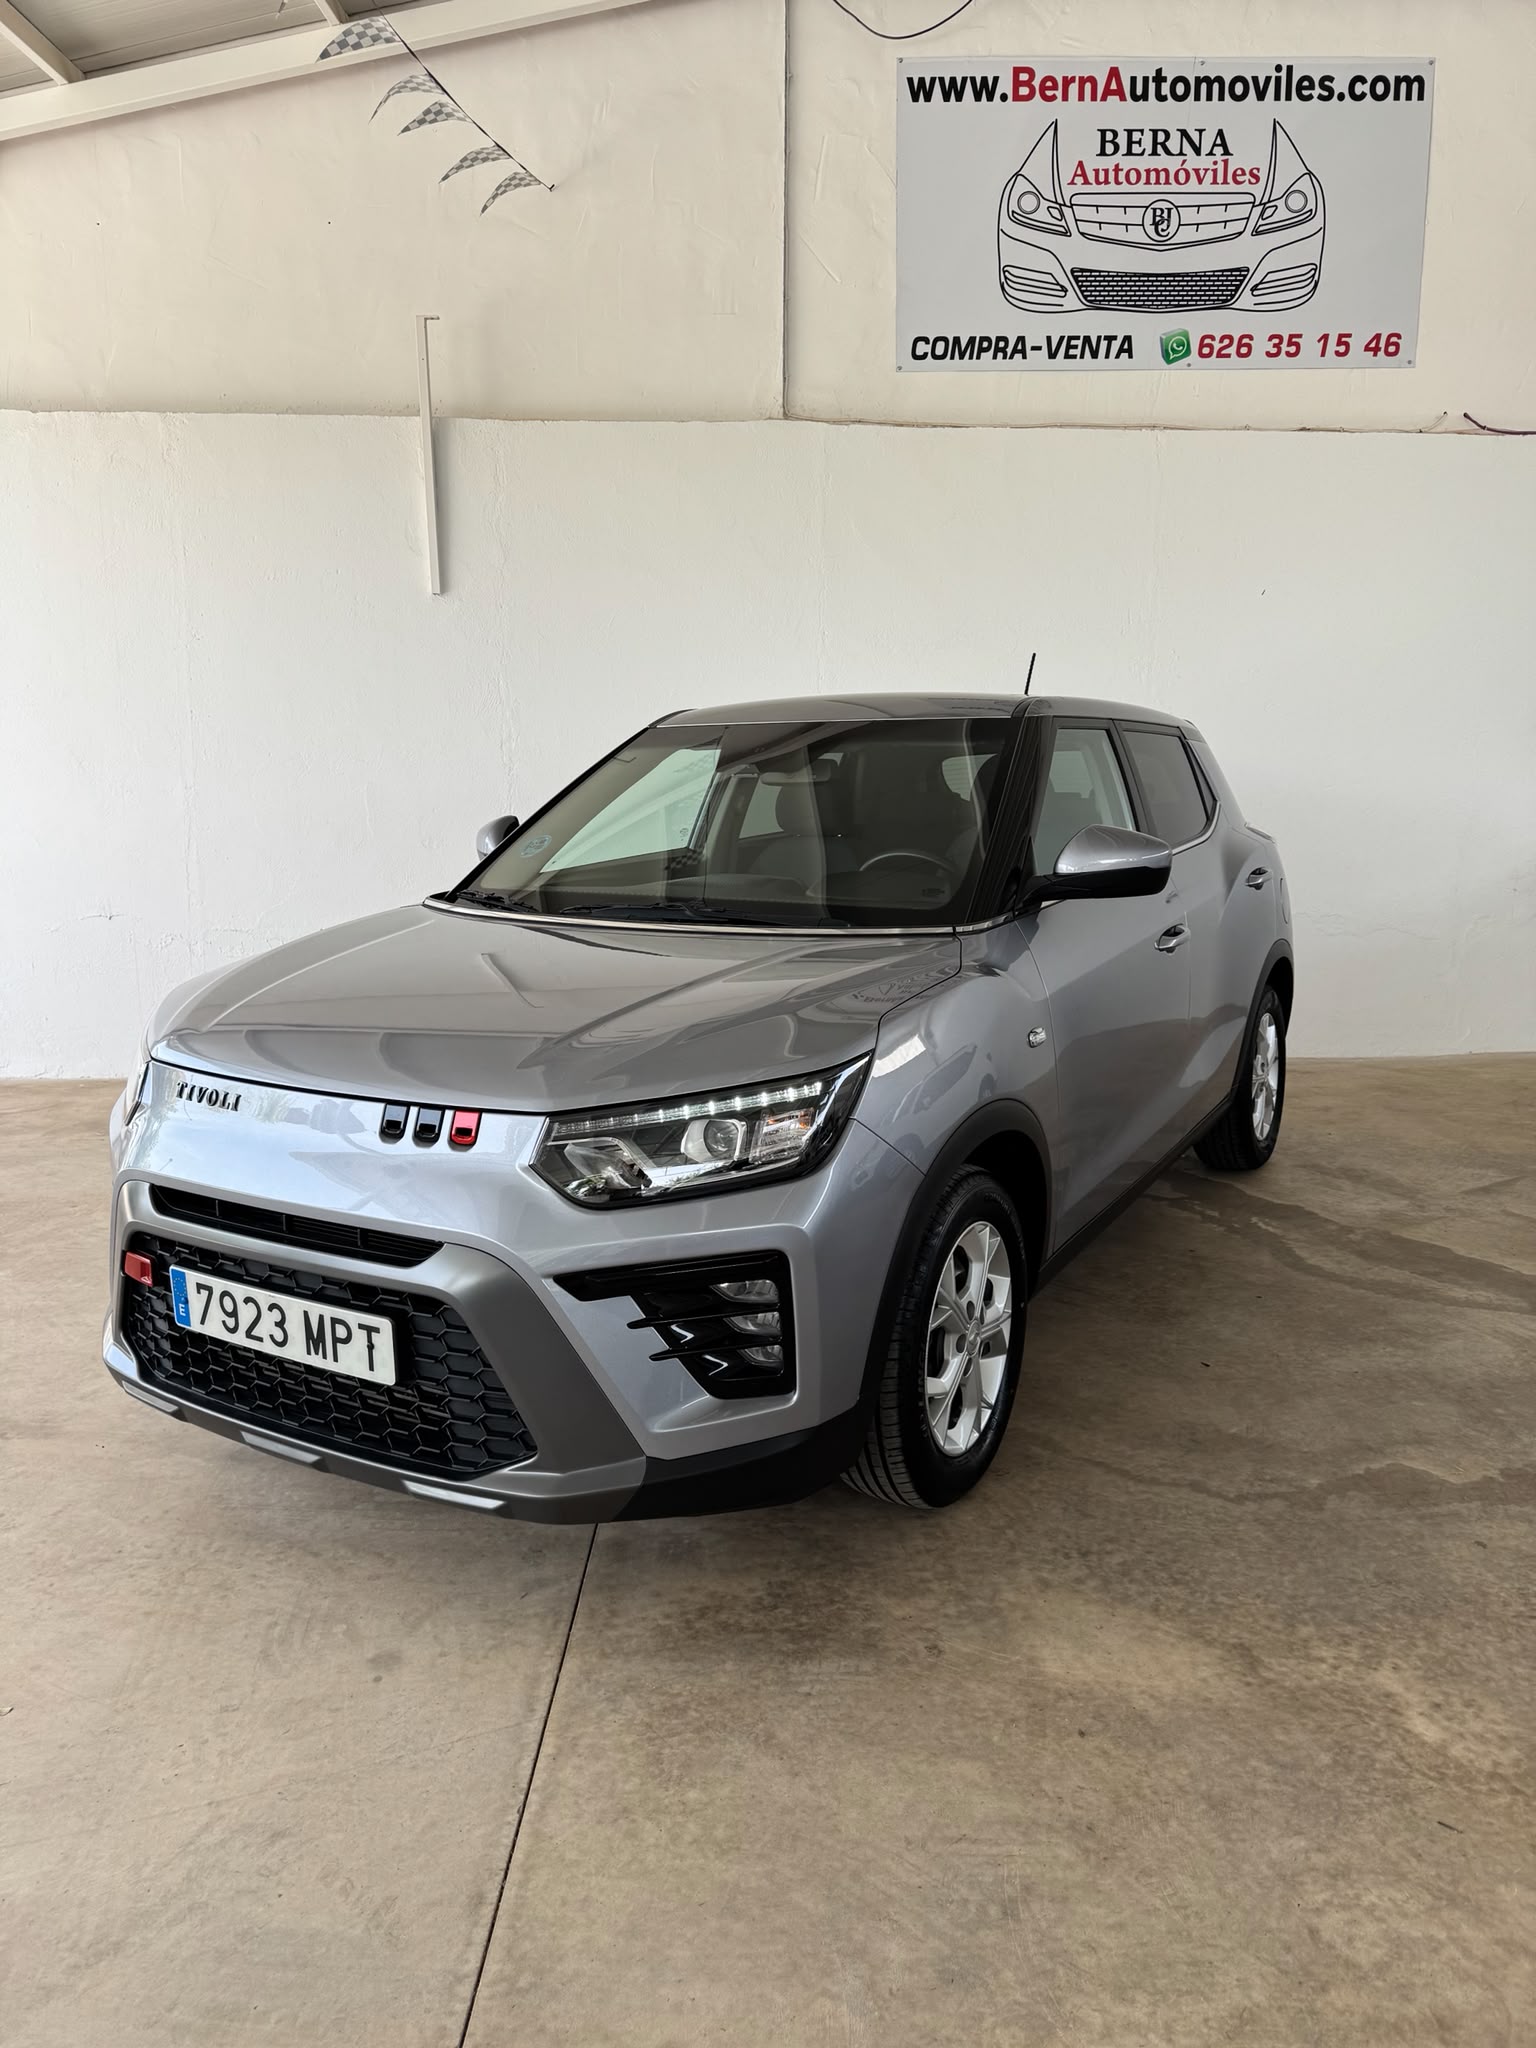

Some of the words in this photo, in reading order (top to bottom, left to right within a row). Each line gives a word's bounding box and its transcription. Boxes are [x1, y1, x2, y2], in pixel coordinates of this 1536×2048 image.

[906, 63, 1427, 104] www.BernAutomoviles.com
[1095, 127, 1234, 158] BERNA
[1067, 158, 1262, 187] Automóviles
[910, 334, 1135, 362] COMPRA-VENTA
[1197, 333, 1254, 360] 626
[1265, 332, 1304, 359] 35
[1317, 332, 1353, 359] 15
[1363, 331, 1402, 359] 46
[176, 1081, 242, 1112] TIVOLI
[179, 1304, 187, 1317] E
[196, 1281, 289, 1348] 7923
[304, 1309, 381, 1372] MPT
